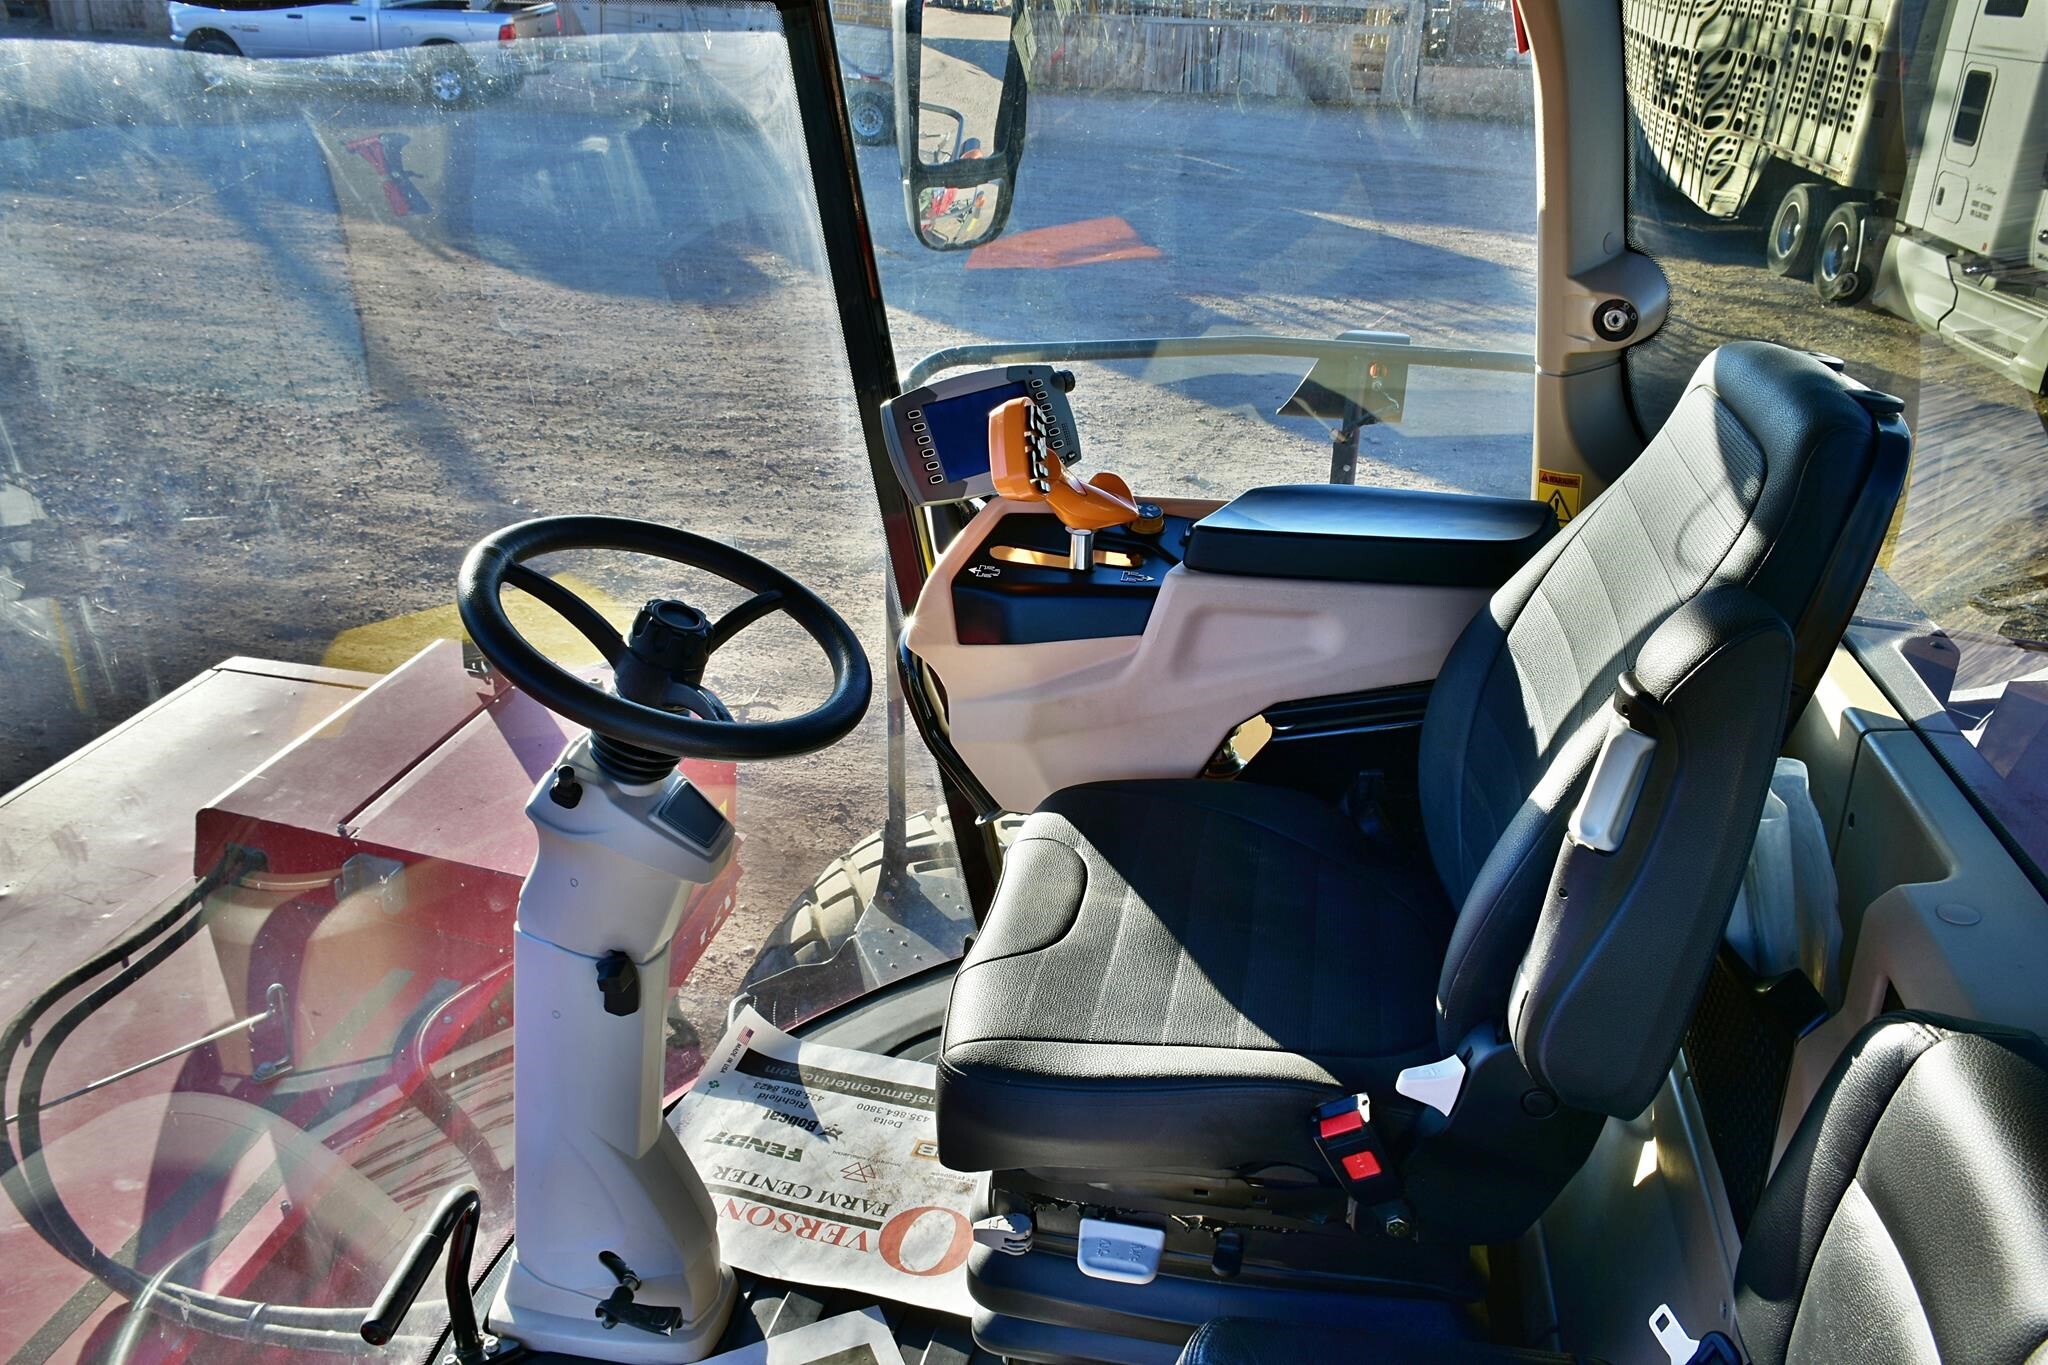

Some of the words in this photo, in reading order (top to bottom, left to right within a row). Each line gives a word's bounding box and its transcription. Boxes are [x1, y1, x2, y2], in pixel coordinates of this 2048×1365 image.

[732, 1043, 742, 1056] MADE
[720, 1063, 730, 1073] USA
[753, 1081, 824, 1104] 435.896.8423
[757, 1092, 808, 1109] Richfield
[763, 1109, 819, 1132] Bobcat
[857, 1103, 930, 1123] 435.864.3800
[873, 1116, 903, 1129] Delta
[704, 1131, 804, 1162] FENDT
[712, 1165, 814, 1199] CENTER
[816, 1190, 890, 1217] FARM
[709, 1195, 974, 1276] OVERSON
